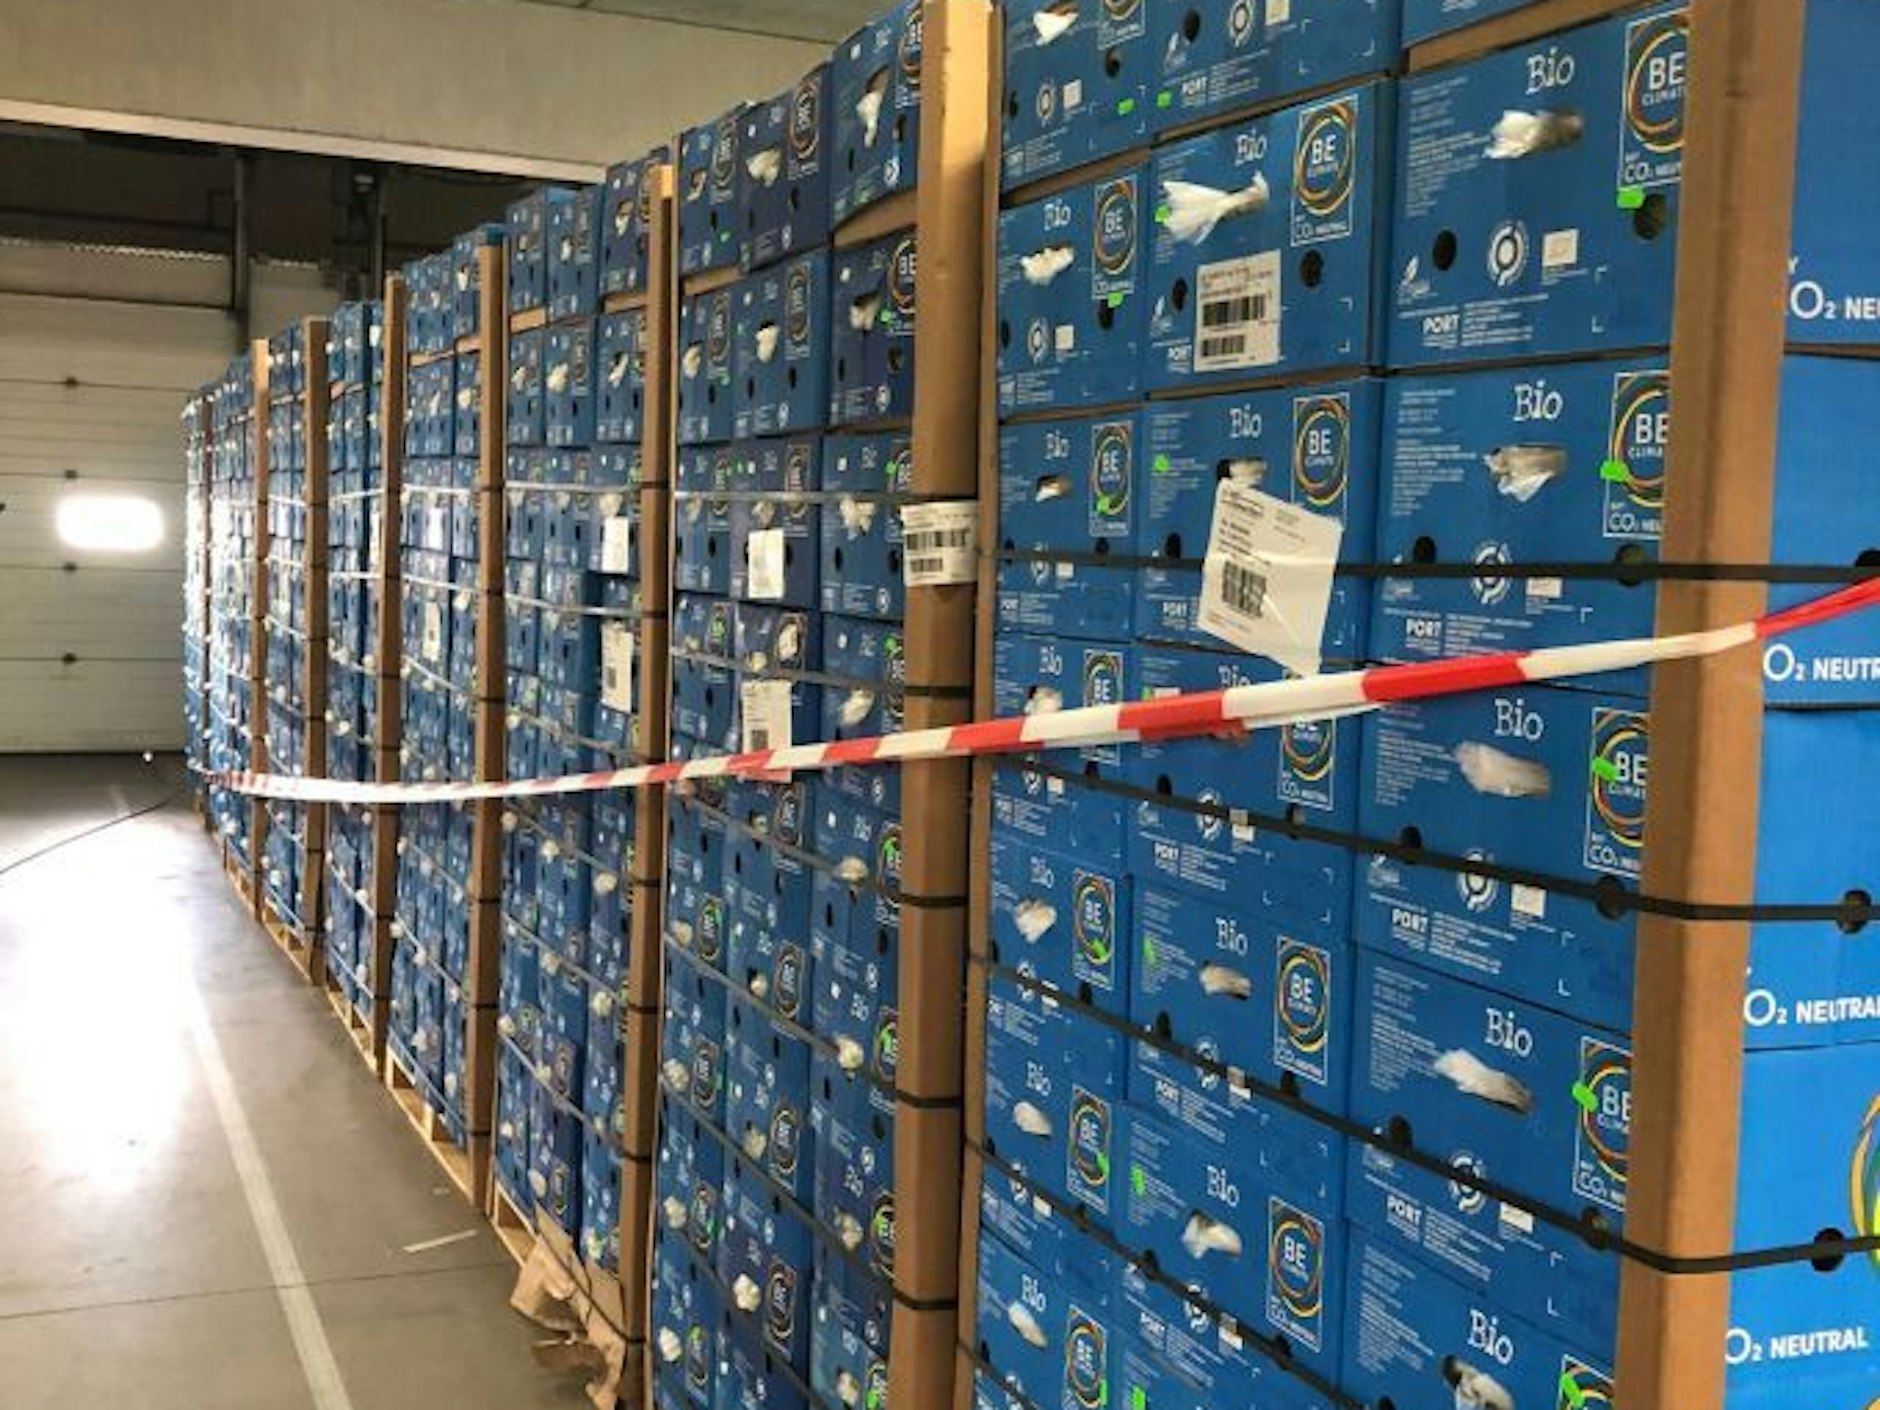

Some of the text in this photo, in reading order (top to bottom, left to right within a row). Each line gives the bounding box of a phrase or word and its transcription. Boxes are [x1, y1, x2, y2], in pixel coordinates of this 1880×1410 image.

[1525, 46, 1575, 95] Bio
[1650, 52, 1686, 91] BE
[1641, 89, 1684, 106] CLIMAT
[1235, 128, 1268, 166] Bio
[1311, 134, 1337, 165] BE
[1104, 207, 1126, 234] BE
[1788, 280, 1880, 320] O2 NE
[1423, 314, 1460, 335] PORT
[1513, 380, 1564, 421] Bio
[1229, 404, 1262, 438] Bio
[1635, 413, 1670, 444] BE
[1308, 429, 1332, 456] BE
[1627, 446, 1664, 460] CLIMA
[1102, 450, 1120, 474] BE
[1406, 618, 1441, 639] PORT
[1763, 643, 1880, 682] O2 NEUTR
[1494, 698, 1544, 741] Bio
[1615, 750, 1649, 786] BE
[1215, 916, 1249, 957] Bio
[1392, 907, 1428, 934] PORT
[1290, 973, 1315, 1005] BE
[1743, 988, 1788, 1027] O2
[1484, 1007, 1533, 1058] Bio
[1602, 1084, 1632, 1121] BE
[1206, 1165, 1240, 1208] Bio
[1387, 1192, 1422, 1227] PORT
[1283, 1235, 1307, 1271] BE
[1022, 1273, 1047, 1312] Bio
[1467, 1308, 1514, 1364] Bio
[1724, 1325, 1869, 1365] O2 NEUTRAL
